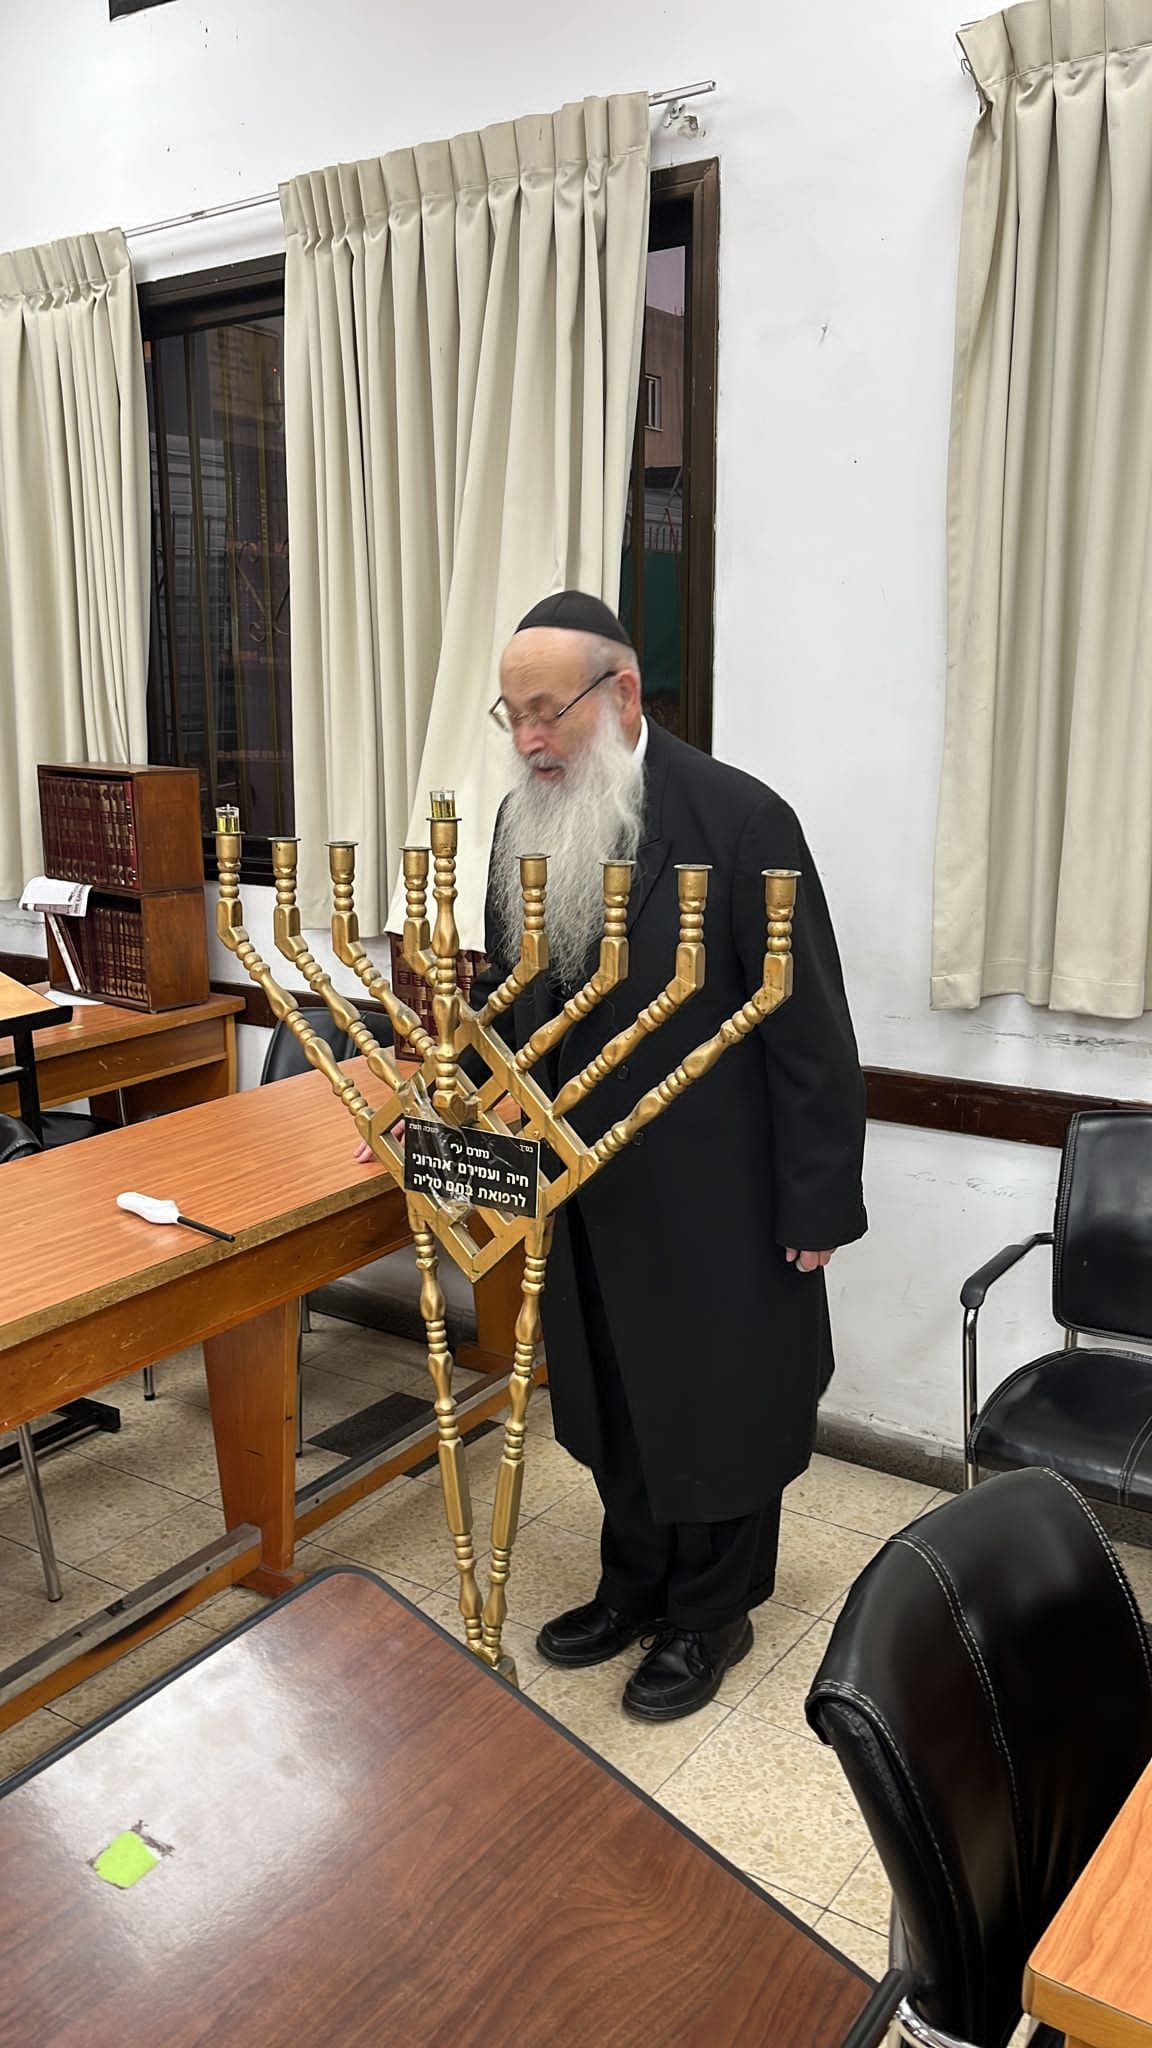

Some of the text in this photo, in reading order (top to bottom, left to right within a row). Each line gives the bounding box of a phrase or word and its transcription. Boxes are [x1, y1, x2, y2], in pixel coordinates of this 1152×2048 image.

[412, 1152, 529, 1188] חיה ועמירם אהרוני
[466, 1147, 490, 1160] נתרם
[413, 1173, 527, 1208] לרפואת בתם טליה
